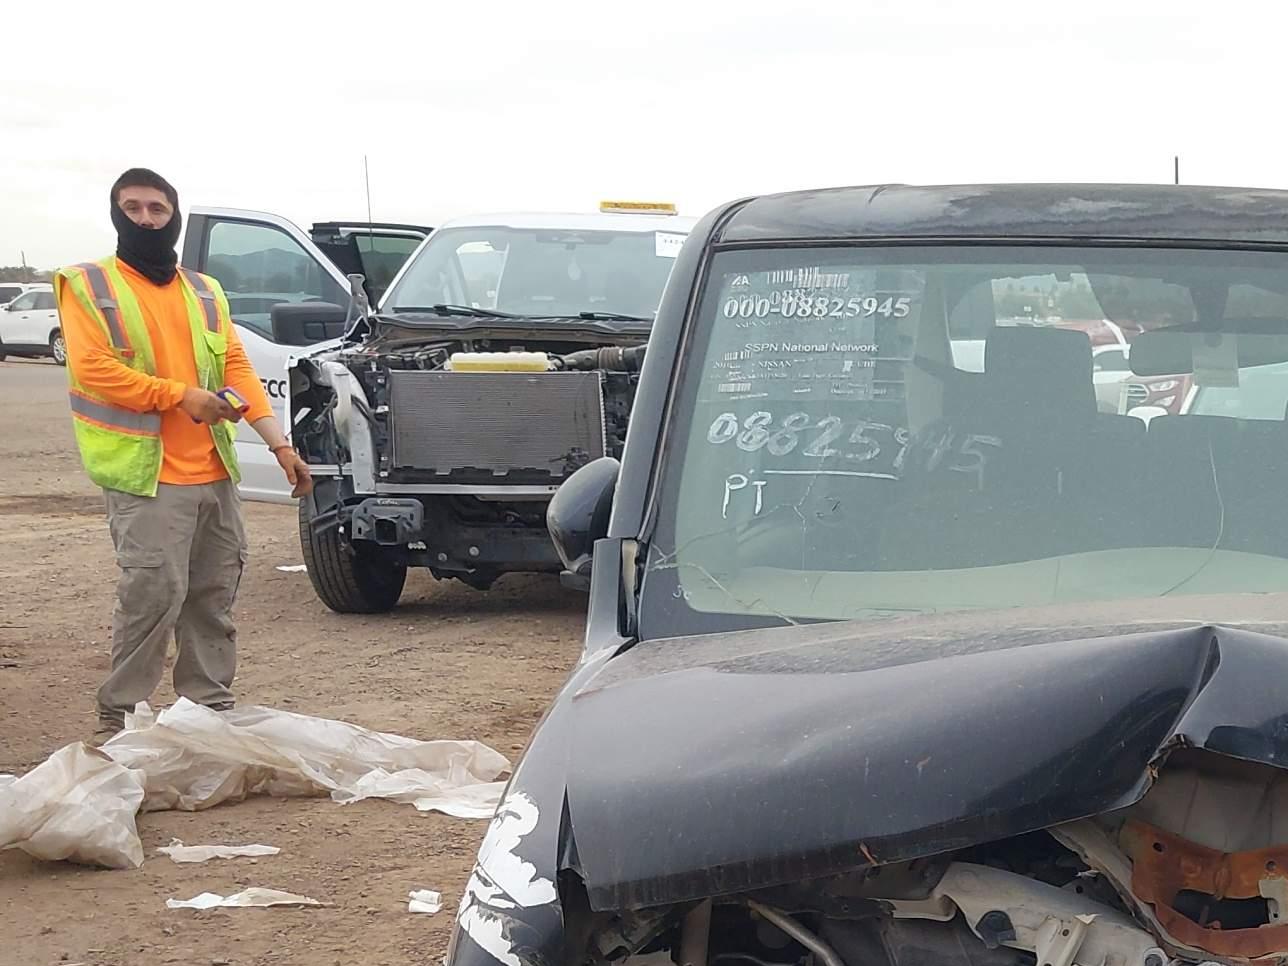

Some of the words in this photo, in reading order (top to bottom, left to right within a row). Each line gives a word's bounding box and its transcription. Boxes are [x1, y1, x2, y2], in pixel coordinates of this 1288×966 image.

[723, 297, 912, 318] 000-08825945
[744, 343, 779, 353] SSPN
[782, 342, 829, 353] National
[831, 342, 880, 353] Network
[721, 473, 767, 520] PT
